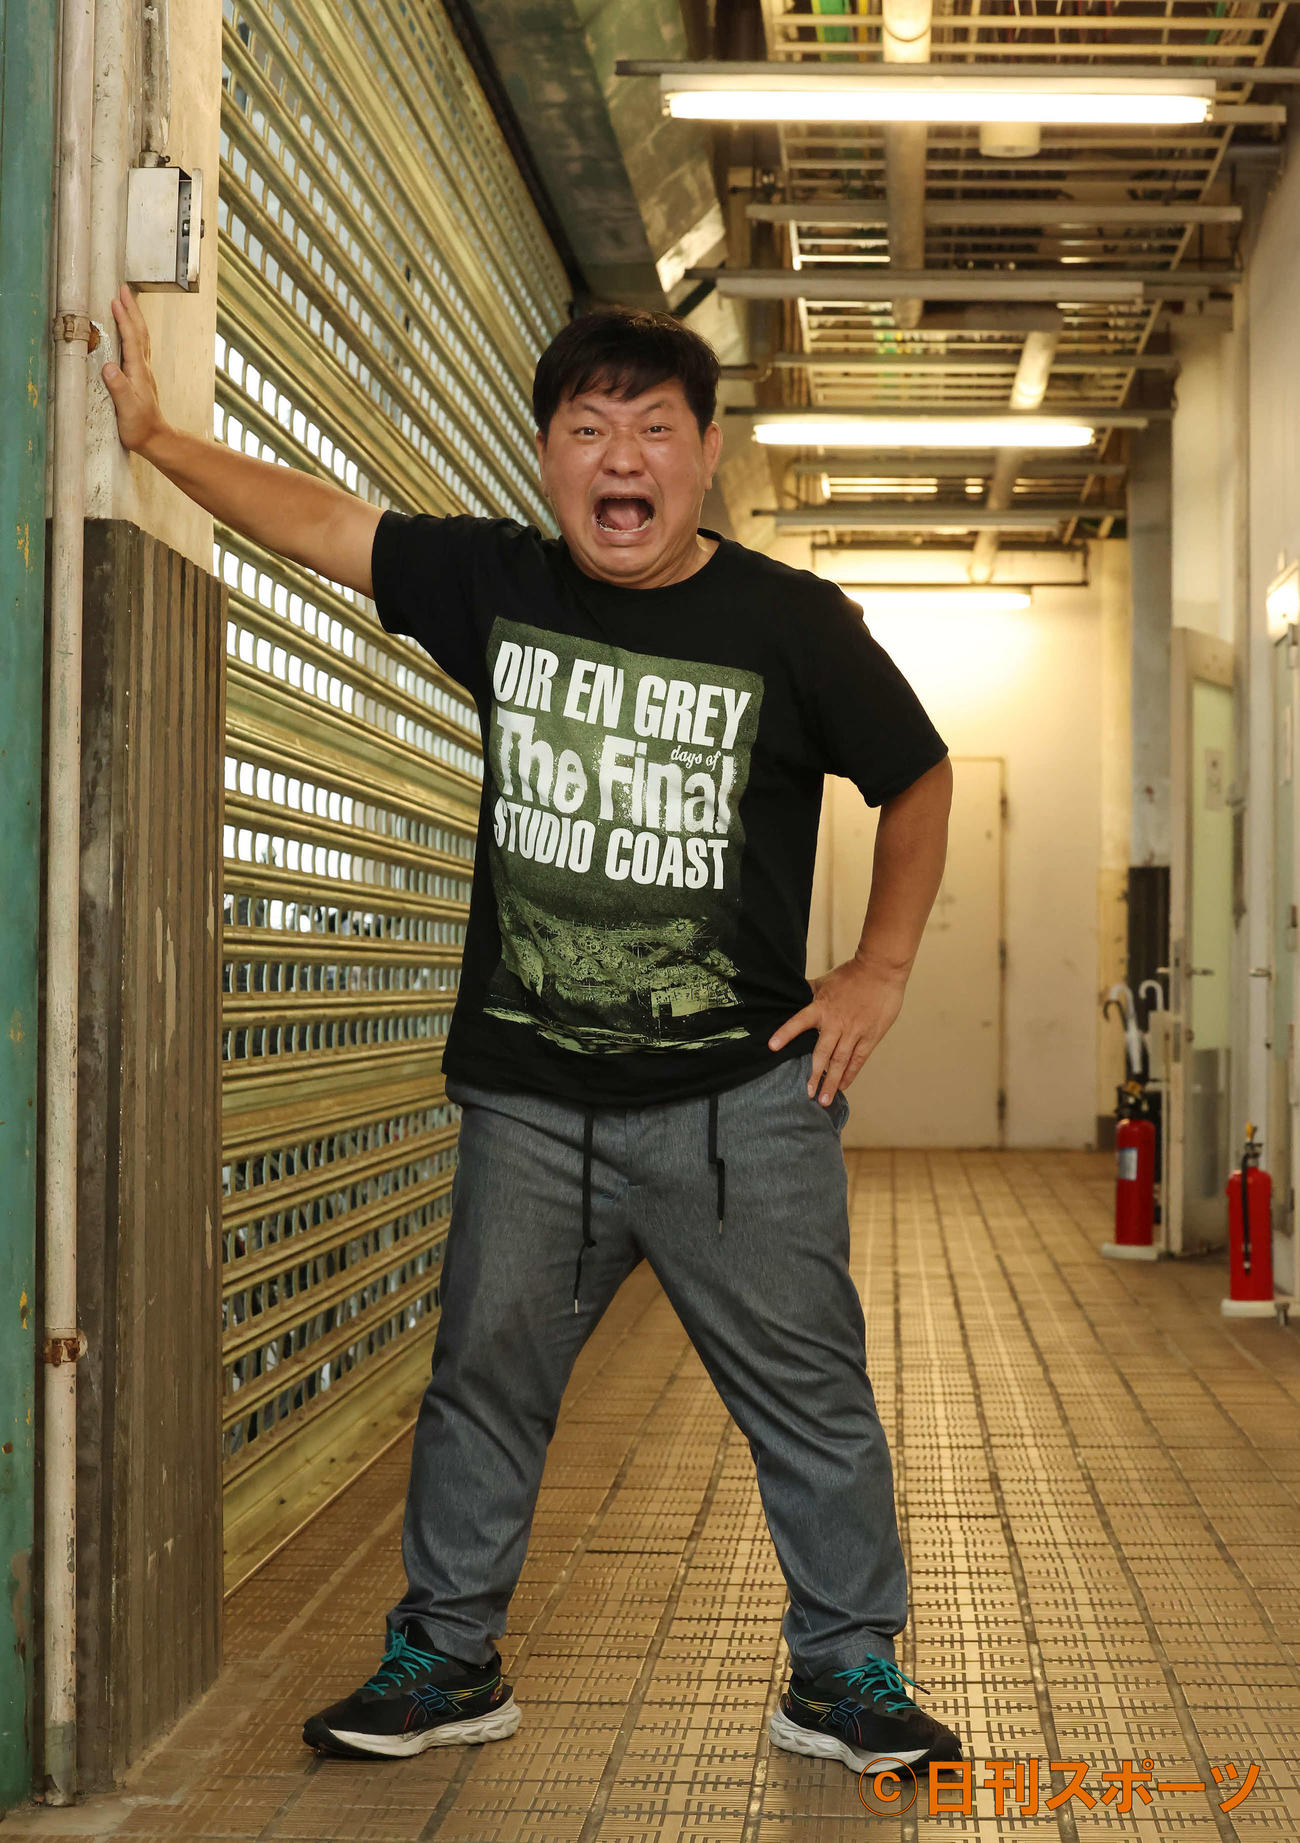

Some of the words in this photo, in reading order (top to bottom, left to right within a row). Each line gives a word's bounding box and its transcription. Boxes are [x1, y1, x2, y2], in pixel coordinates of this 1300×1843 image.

[493, 641, 559, 712] DIR
[563, 658, 624, 729] EN
[634, 675, 752, 750] GREY
[496, 706, 588, 814] The
[598, 735, 737, 834] Final
[670, 745, 703, 769] days
[705, 751, 722, 770] of
[493, 796, 596, 874] STUDIO
[605, 828, 729, 890] COAST
